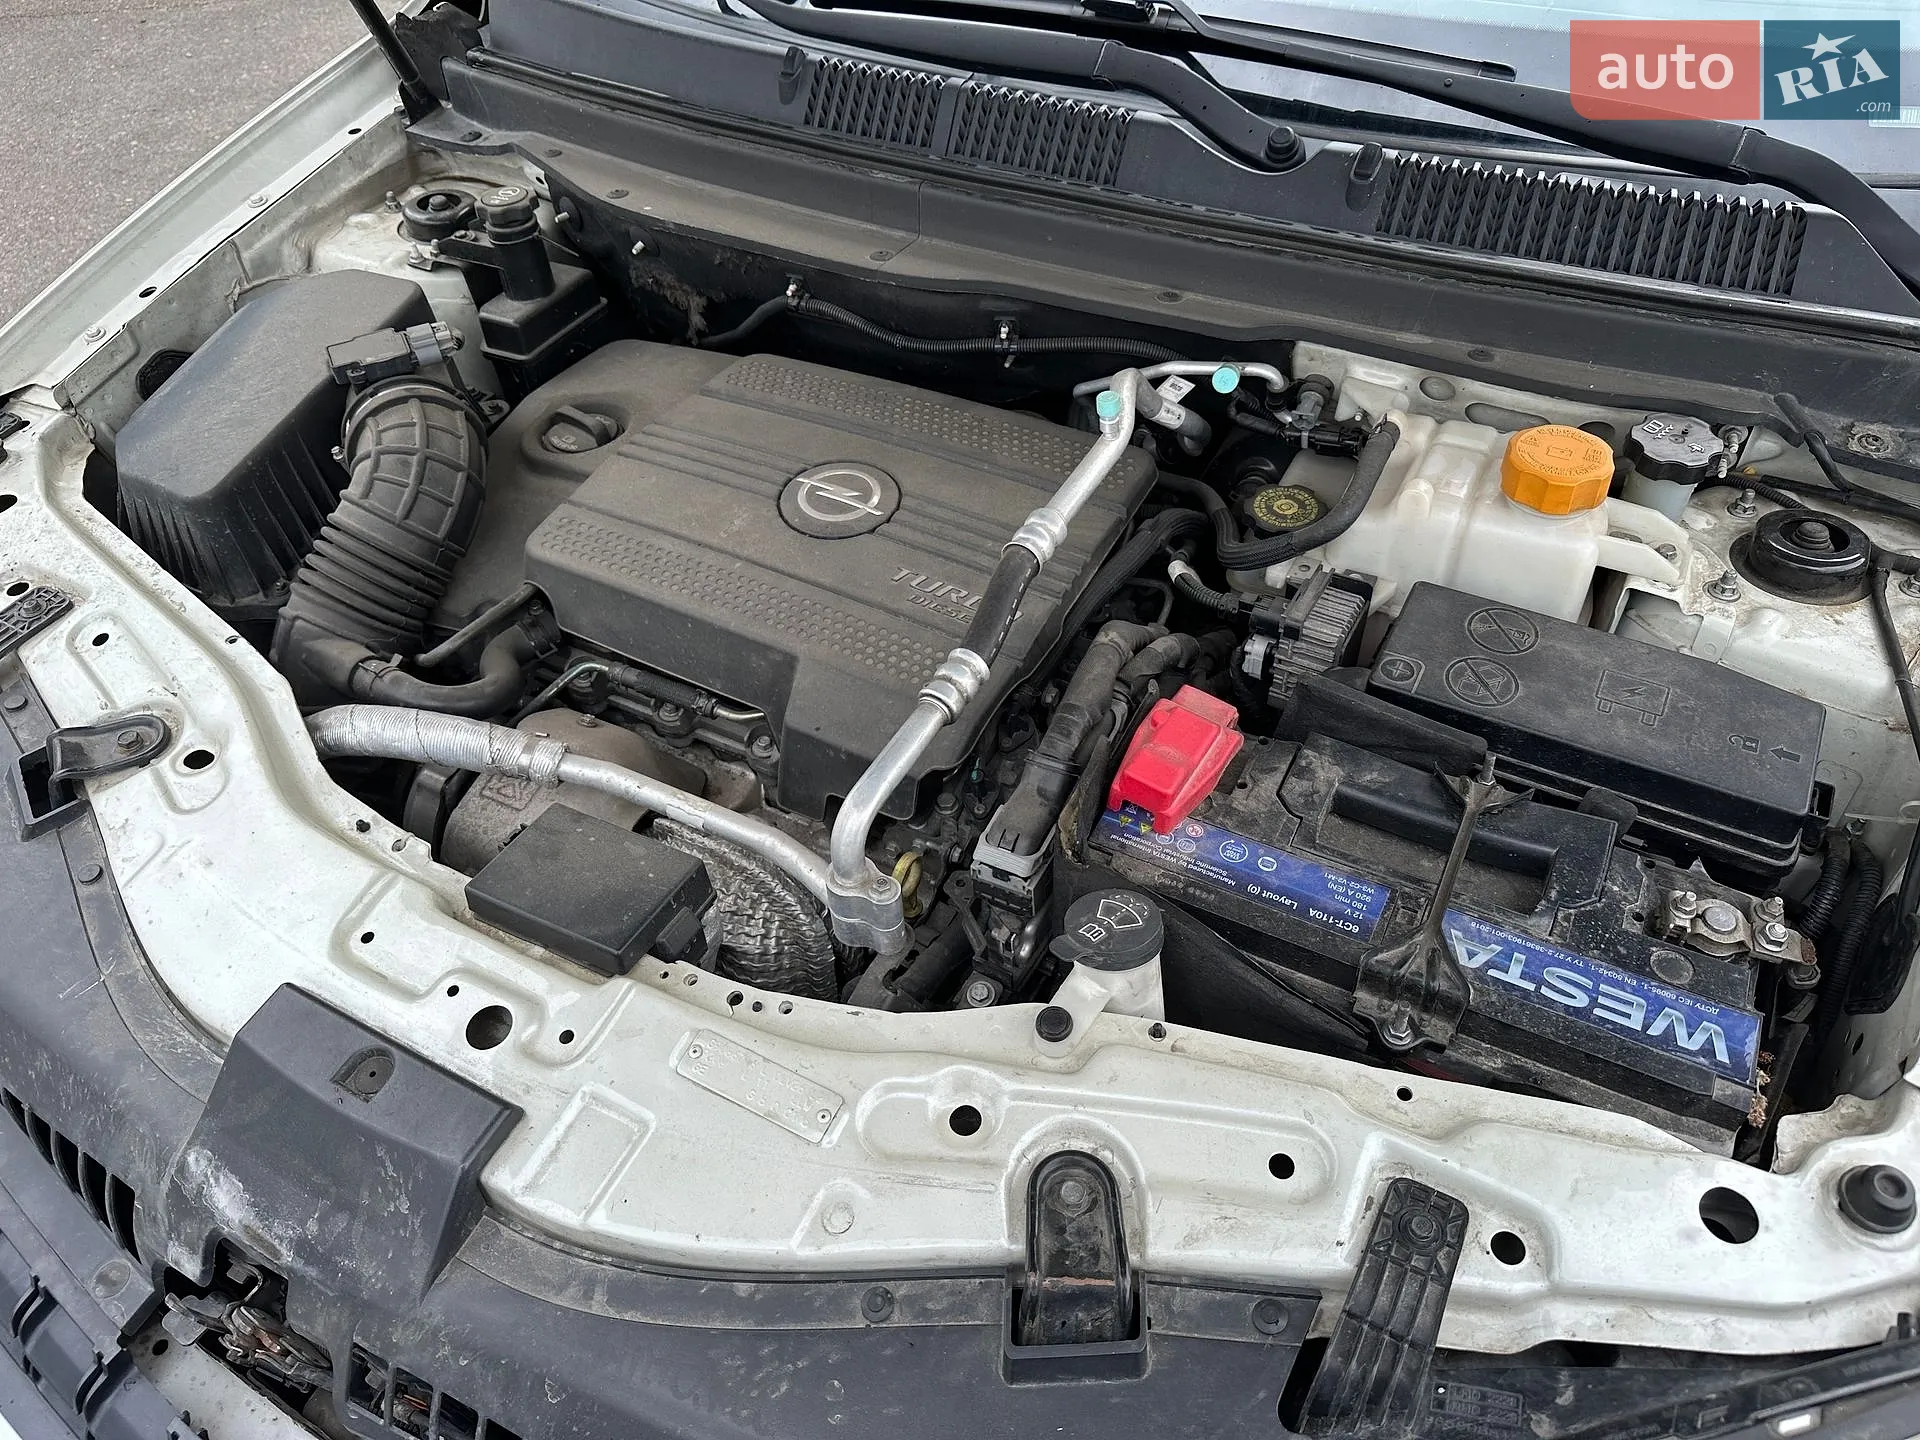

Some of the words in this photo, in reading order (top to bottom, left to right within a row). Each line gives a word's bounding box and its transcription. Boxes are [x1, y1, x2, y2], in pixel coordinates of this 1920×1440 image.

[906, 594, 972, 625] DIESE
[1109, 833, 1151, 853] International
[1123, 832, 1162, 850] Corporation
[1152, 849, 1177, 863] WESTA
[1163, 847, 1194, 863] Industrial
[1177, 858, 1187, 867] by
[1195, 859, 1227, 876] Scientific
[1187, 863, 1235, 885] Manufactured
[1324, 871, 1374, 894] W3-C2-V2-M1
[1326, 881, 1345, 893] (EN)
[1260, 887, 1298, 909] Layout
[1333, 893, 1350, 904] min
[1345, 888, 1354, 896] A
[1355, 891, 1372, 902] 920
[1343, 907, 1351, 915] V
[1351, 899, 1368, 910] 180
[1350, 910, 1364, 919] 12
[1623, 976, 1637, 985] EN
[1450, 928, 1730, 1063] WESTA
[1677, 995, 1693, 1005] IEC
[1694, 1001, 1719, 1015] ДСТУ
